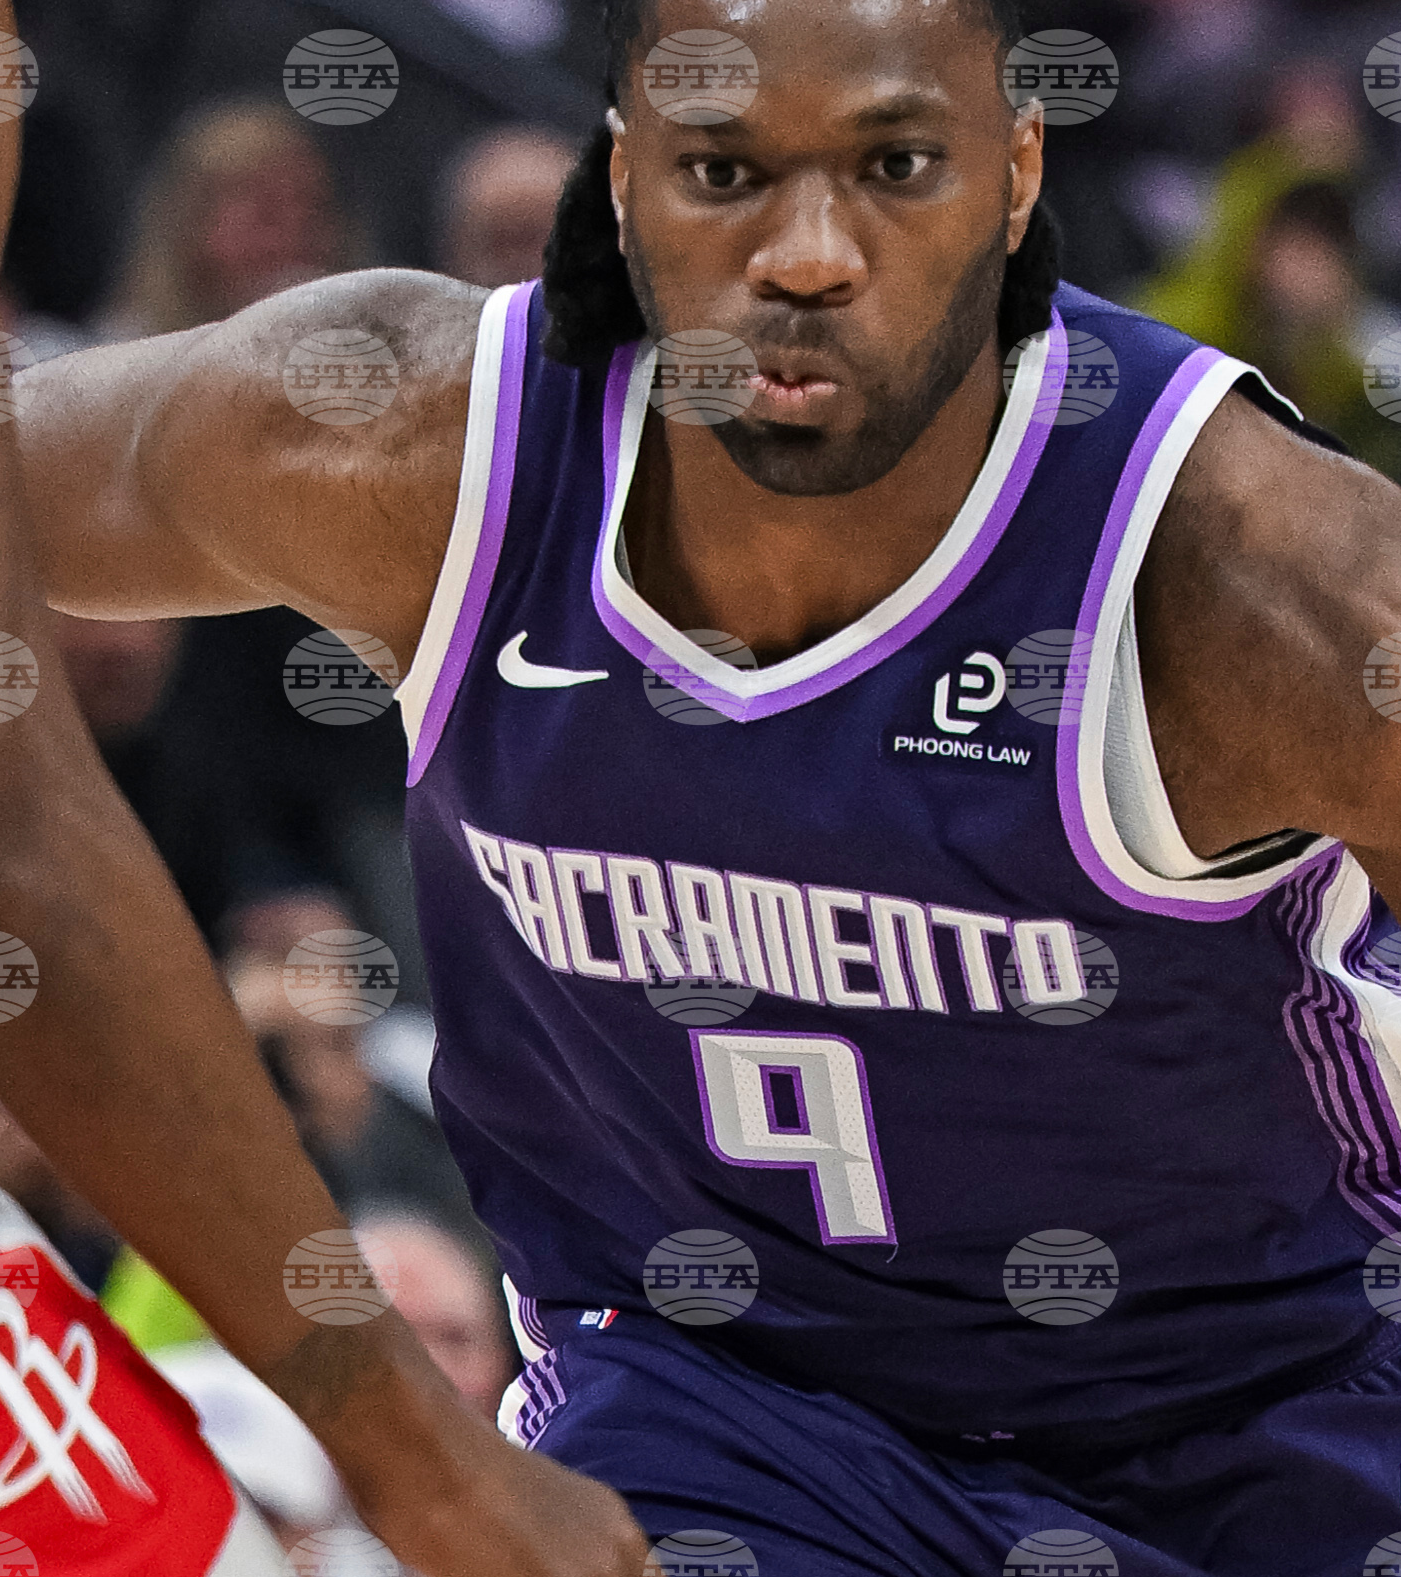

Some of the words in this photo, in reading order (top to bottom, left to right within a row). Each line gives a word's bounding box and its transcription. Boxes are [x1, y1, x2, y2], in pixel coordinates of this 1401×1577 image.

[894, 736, 984, 760] PHOONG
[987, 745, 1031, 766] LAW
[461, 821, 1087, 1013] SACRAMENTO
[689, 1029, 898, 1245] 9
